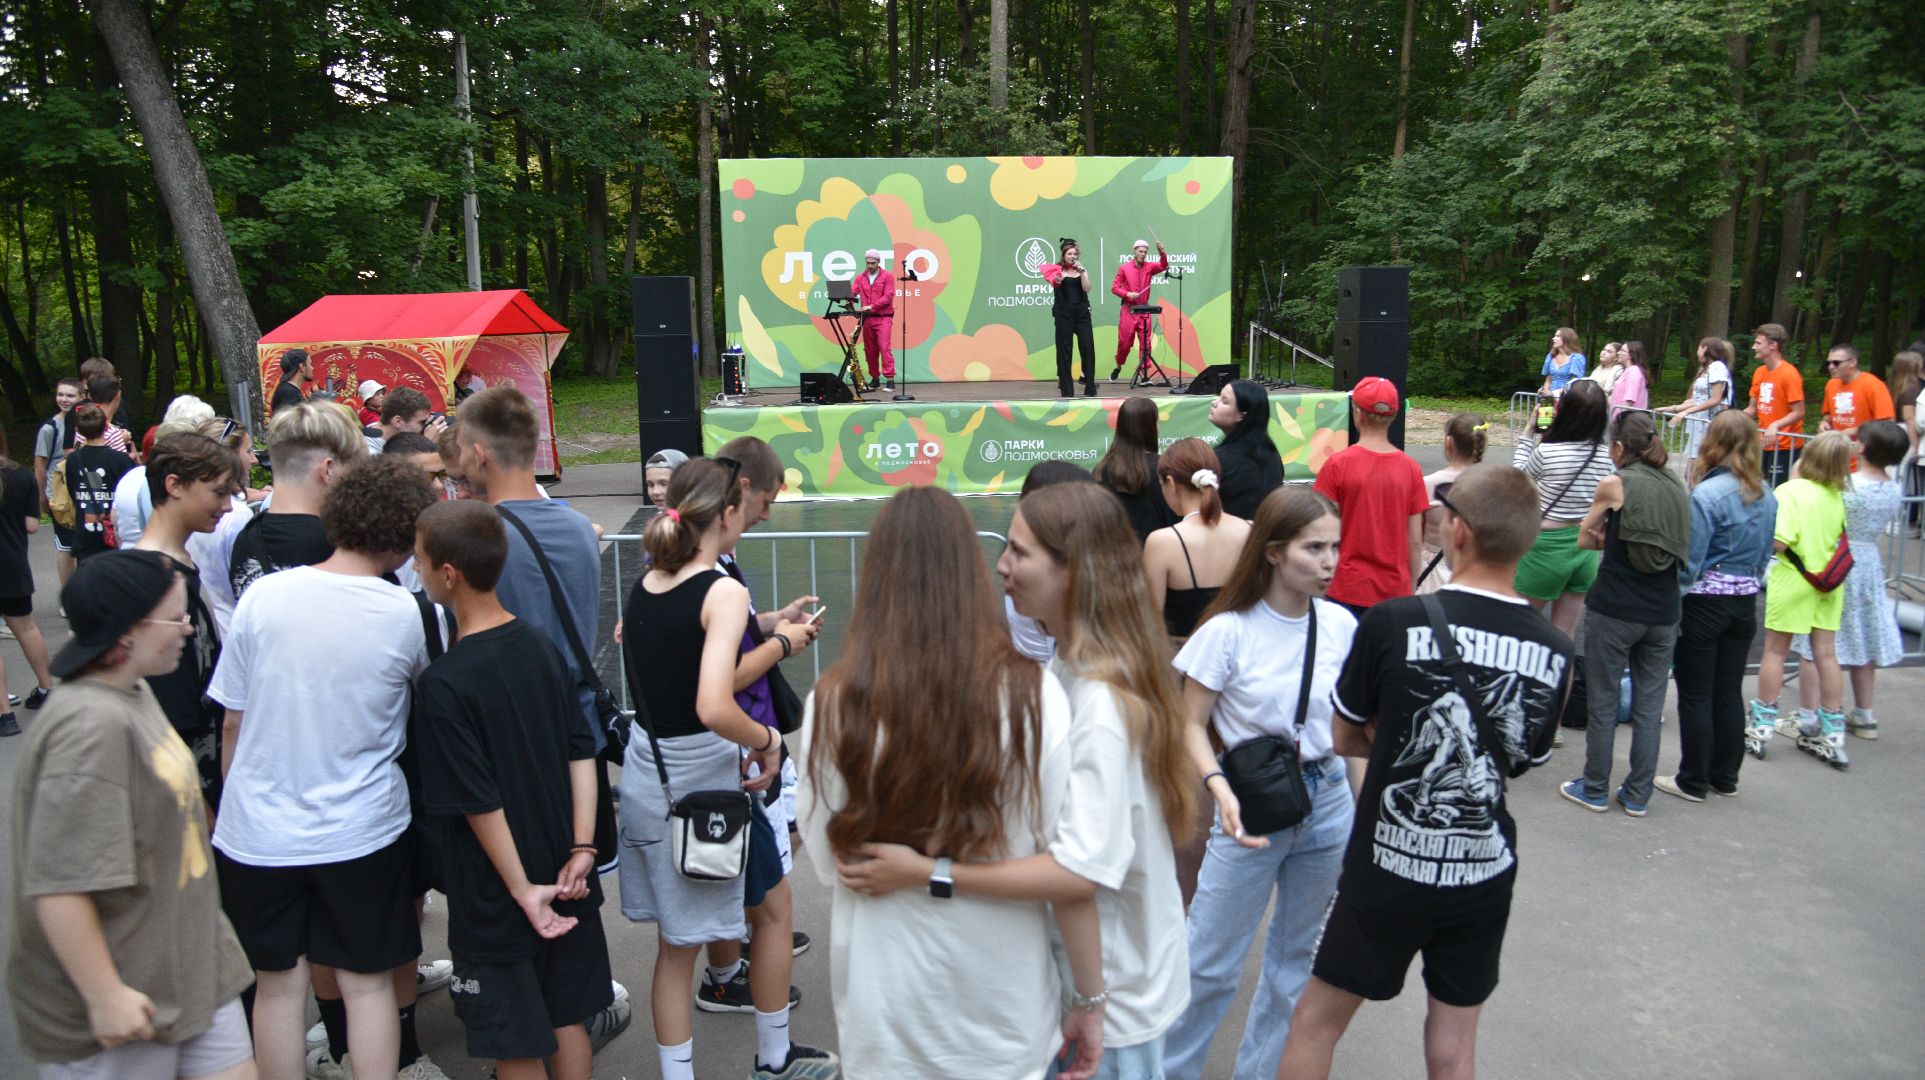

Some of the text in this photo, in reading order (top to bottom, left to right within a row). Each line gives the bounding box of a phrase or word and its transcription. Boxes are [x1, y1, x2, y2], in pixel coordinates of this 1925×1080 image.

[988, 296, 1055, 307] ПОДМОСК
[865, 441, 940, 459] лето
[1004, 439, 1045, 450] ПАРКИ
[1004, 449, 1097, 462] ПОДМОСКОВЬЯ
